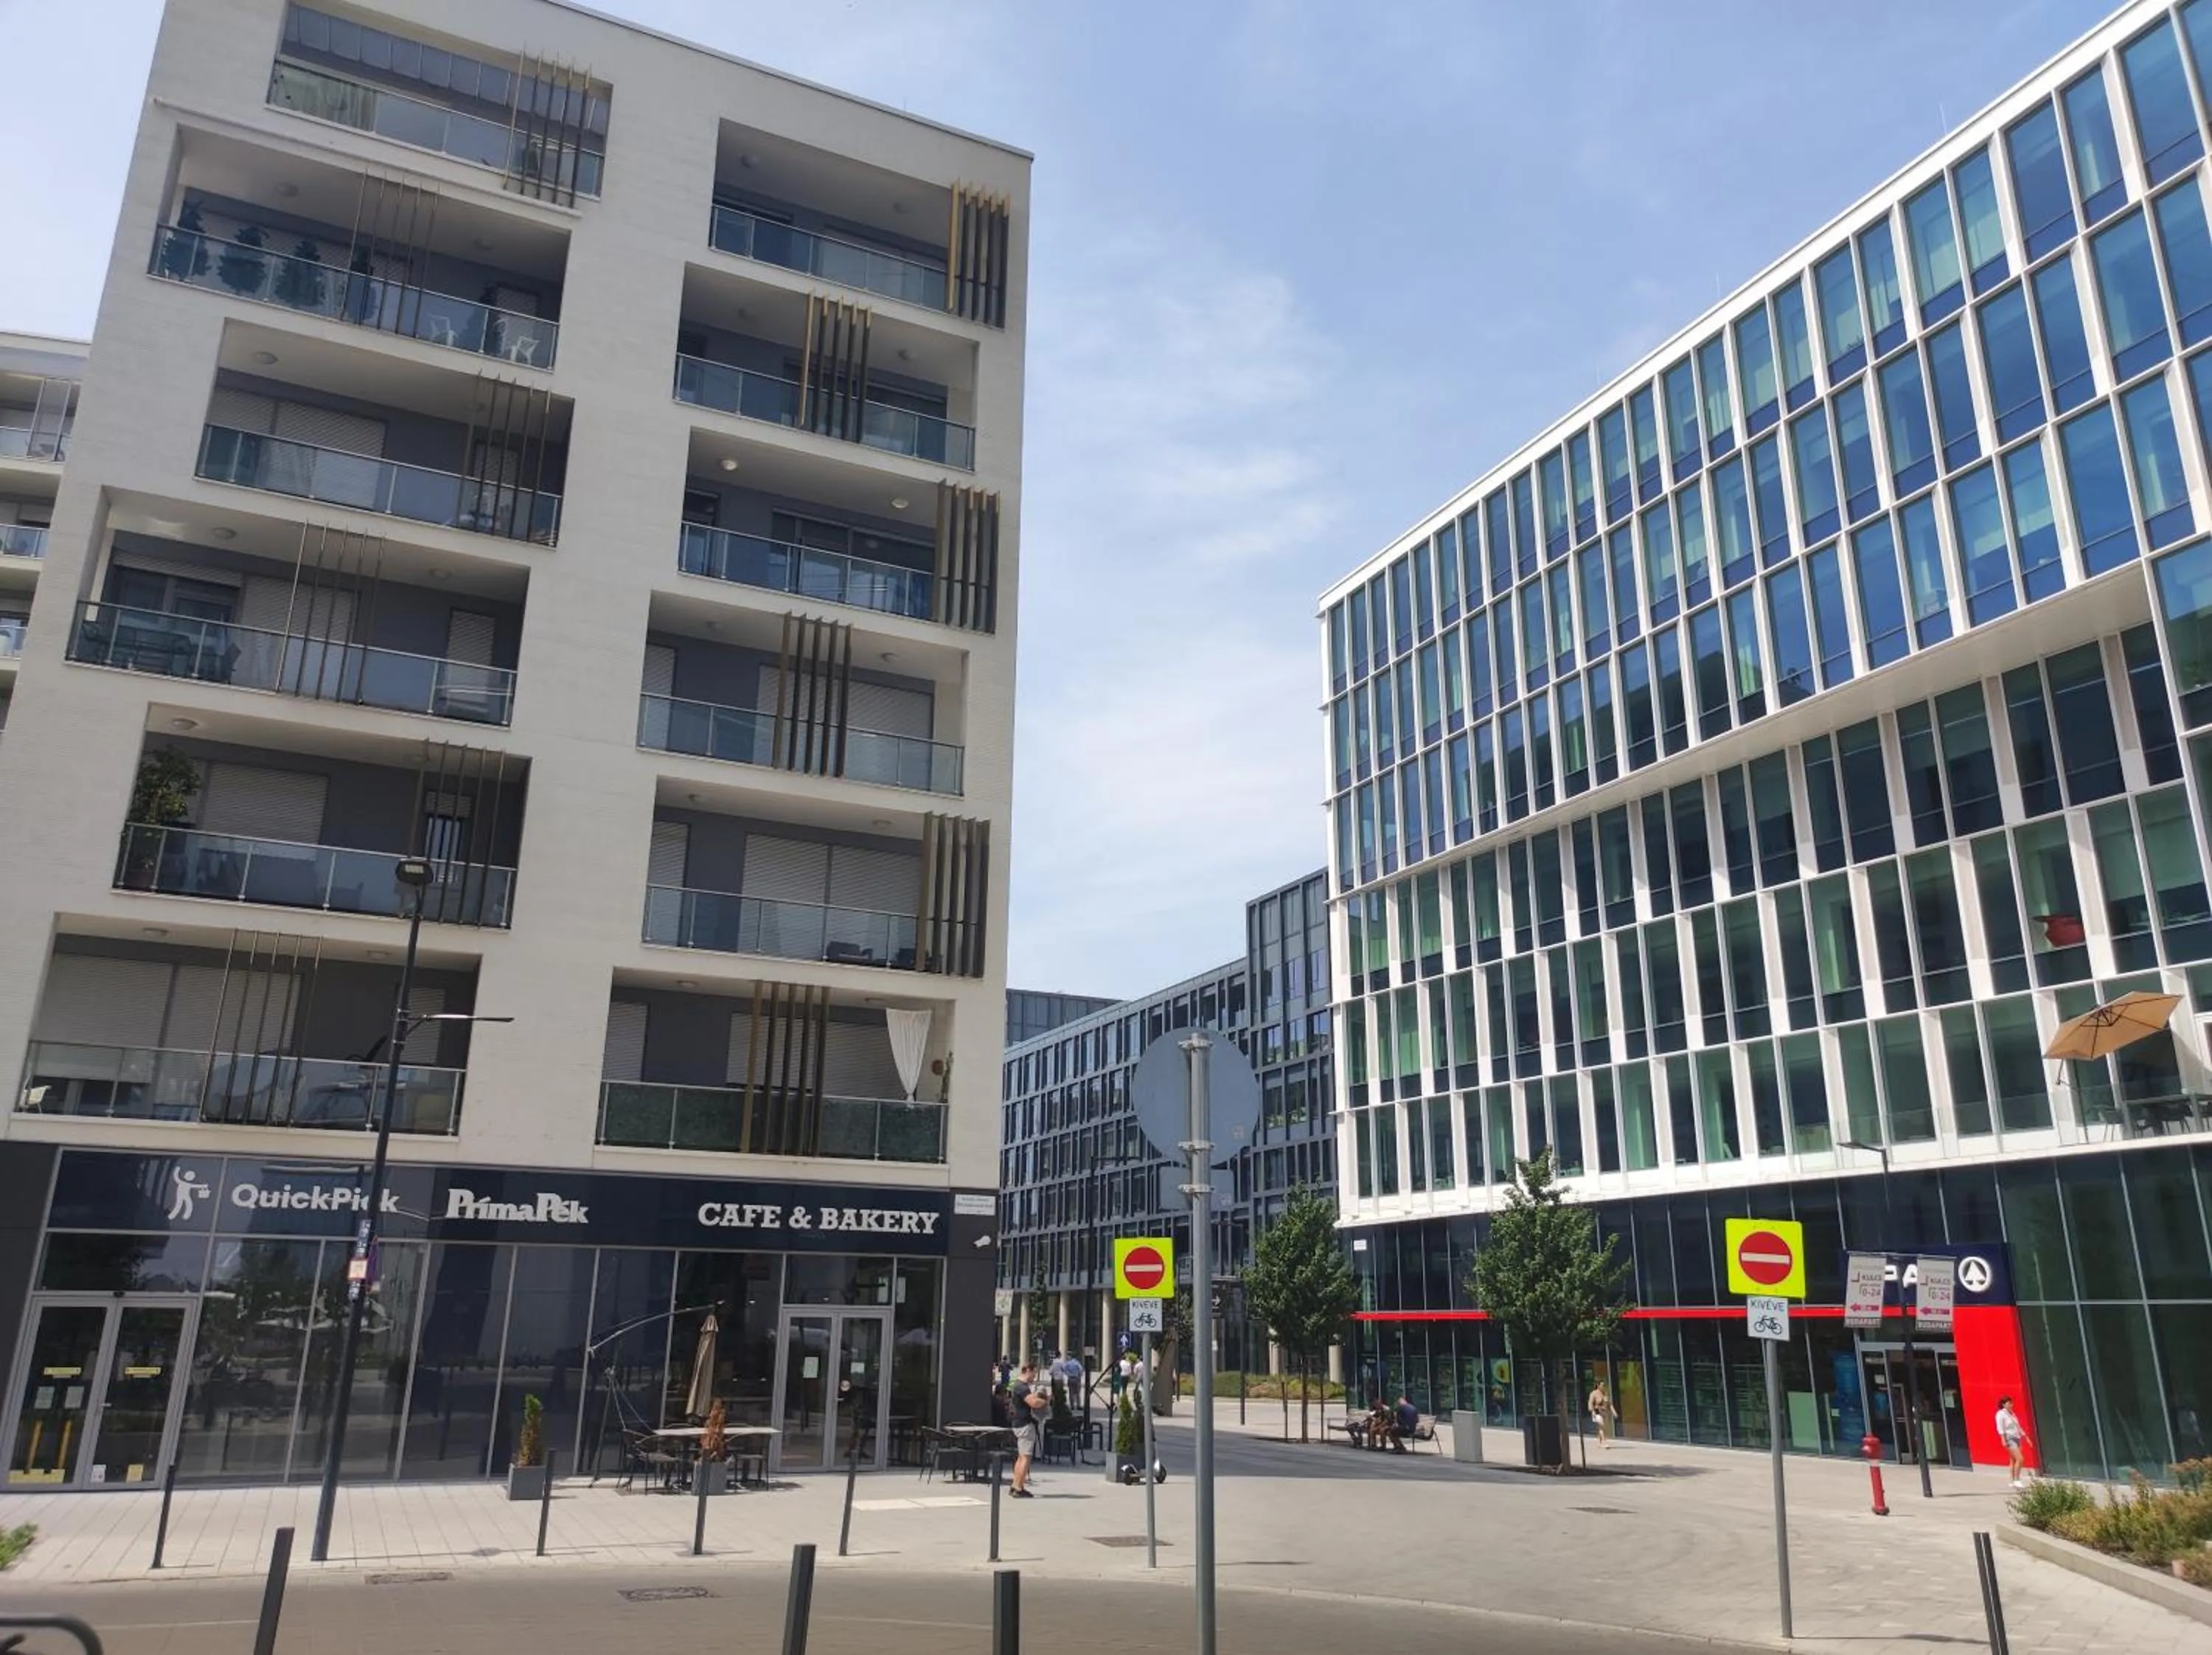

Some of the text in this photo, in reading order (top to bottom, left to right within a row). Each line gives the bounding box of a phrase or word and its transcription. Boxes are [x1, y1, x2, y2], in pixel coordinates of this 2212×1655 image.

[698, 1203, 939, 1234] CAFE & BAKERY
